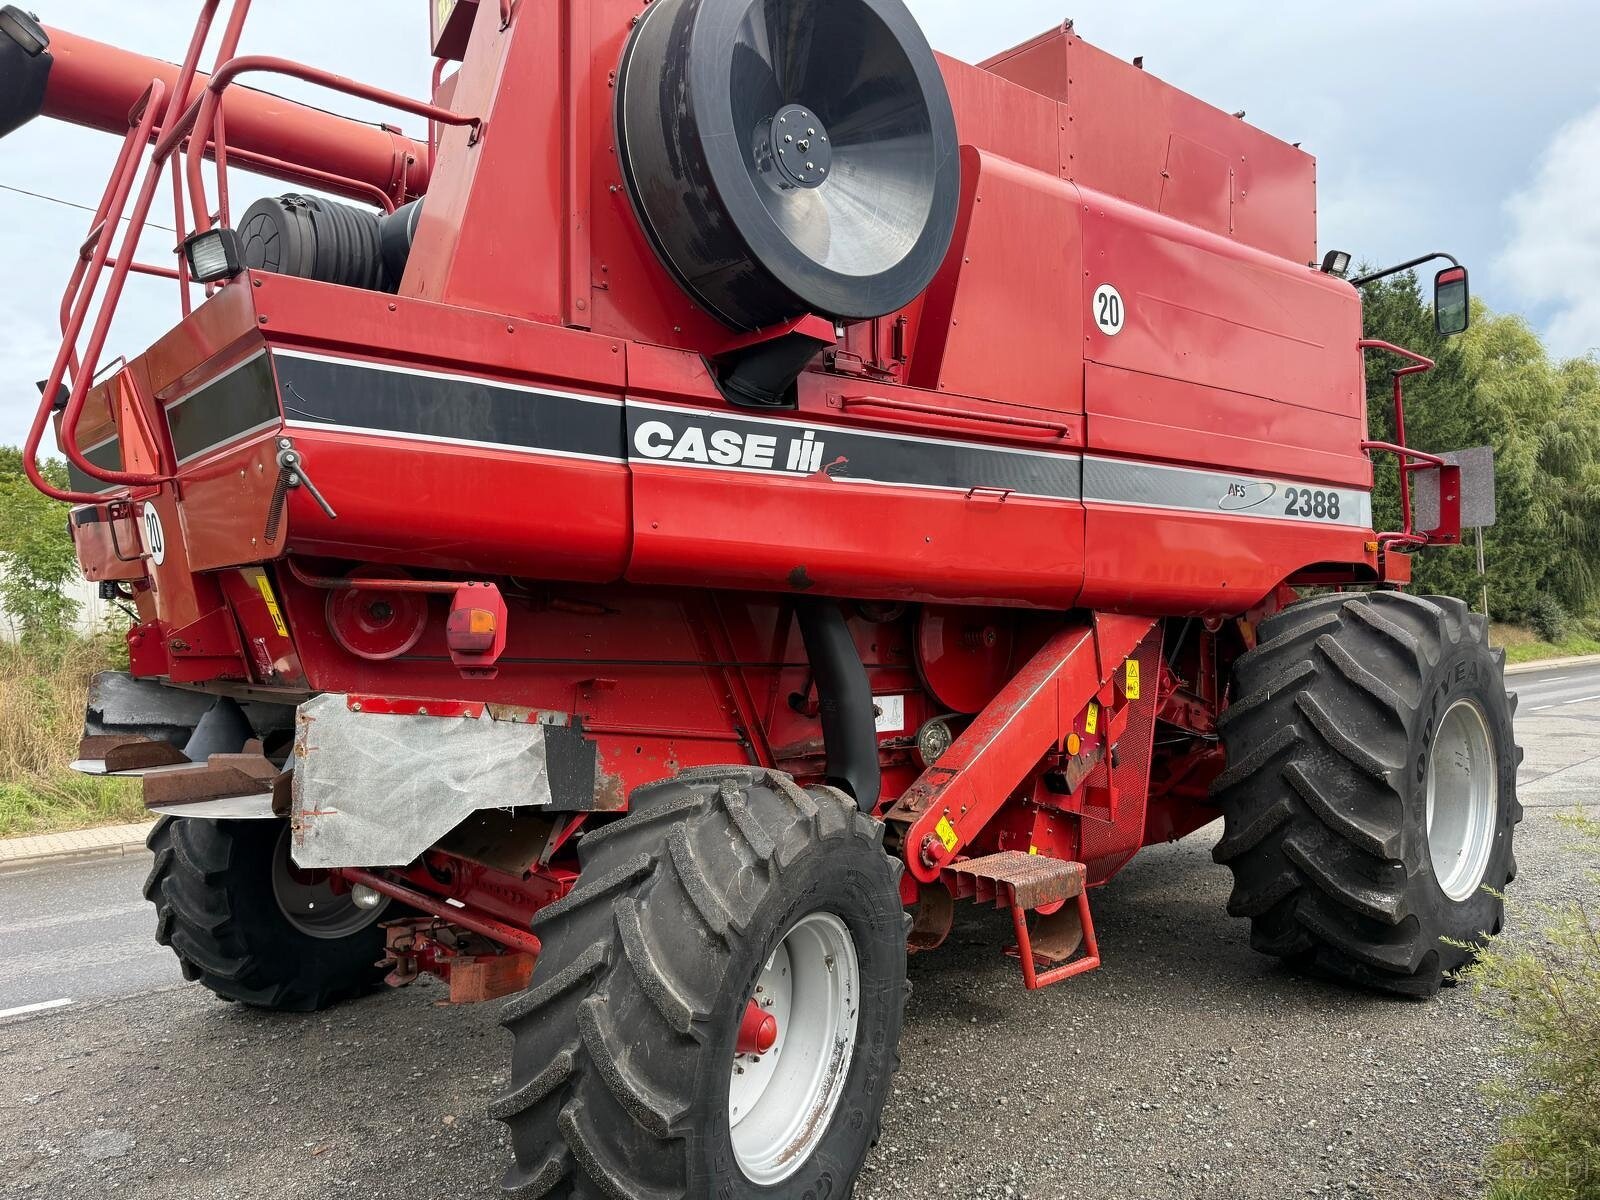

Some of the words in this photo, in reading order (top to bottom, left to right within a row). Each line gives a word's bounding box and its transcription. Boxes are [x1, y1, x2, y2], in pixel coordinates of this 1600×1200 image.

[1098, 292, 1119, 327] 20
[634, 421, 777, 468] CASE
[1228, 482, 1246, 498] AFS
[1284, 487, 1340, 520] 2388
[146, 512, 162, 553] 20
